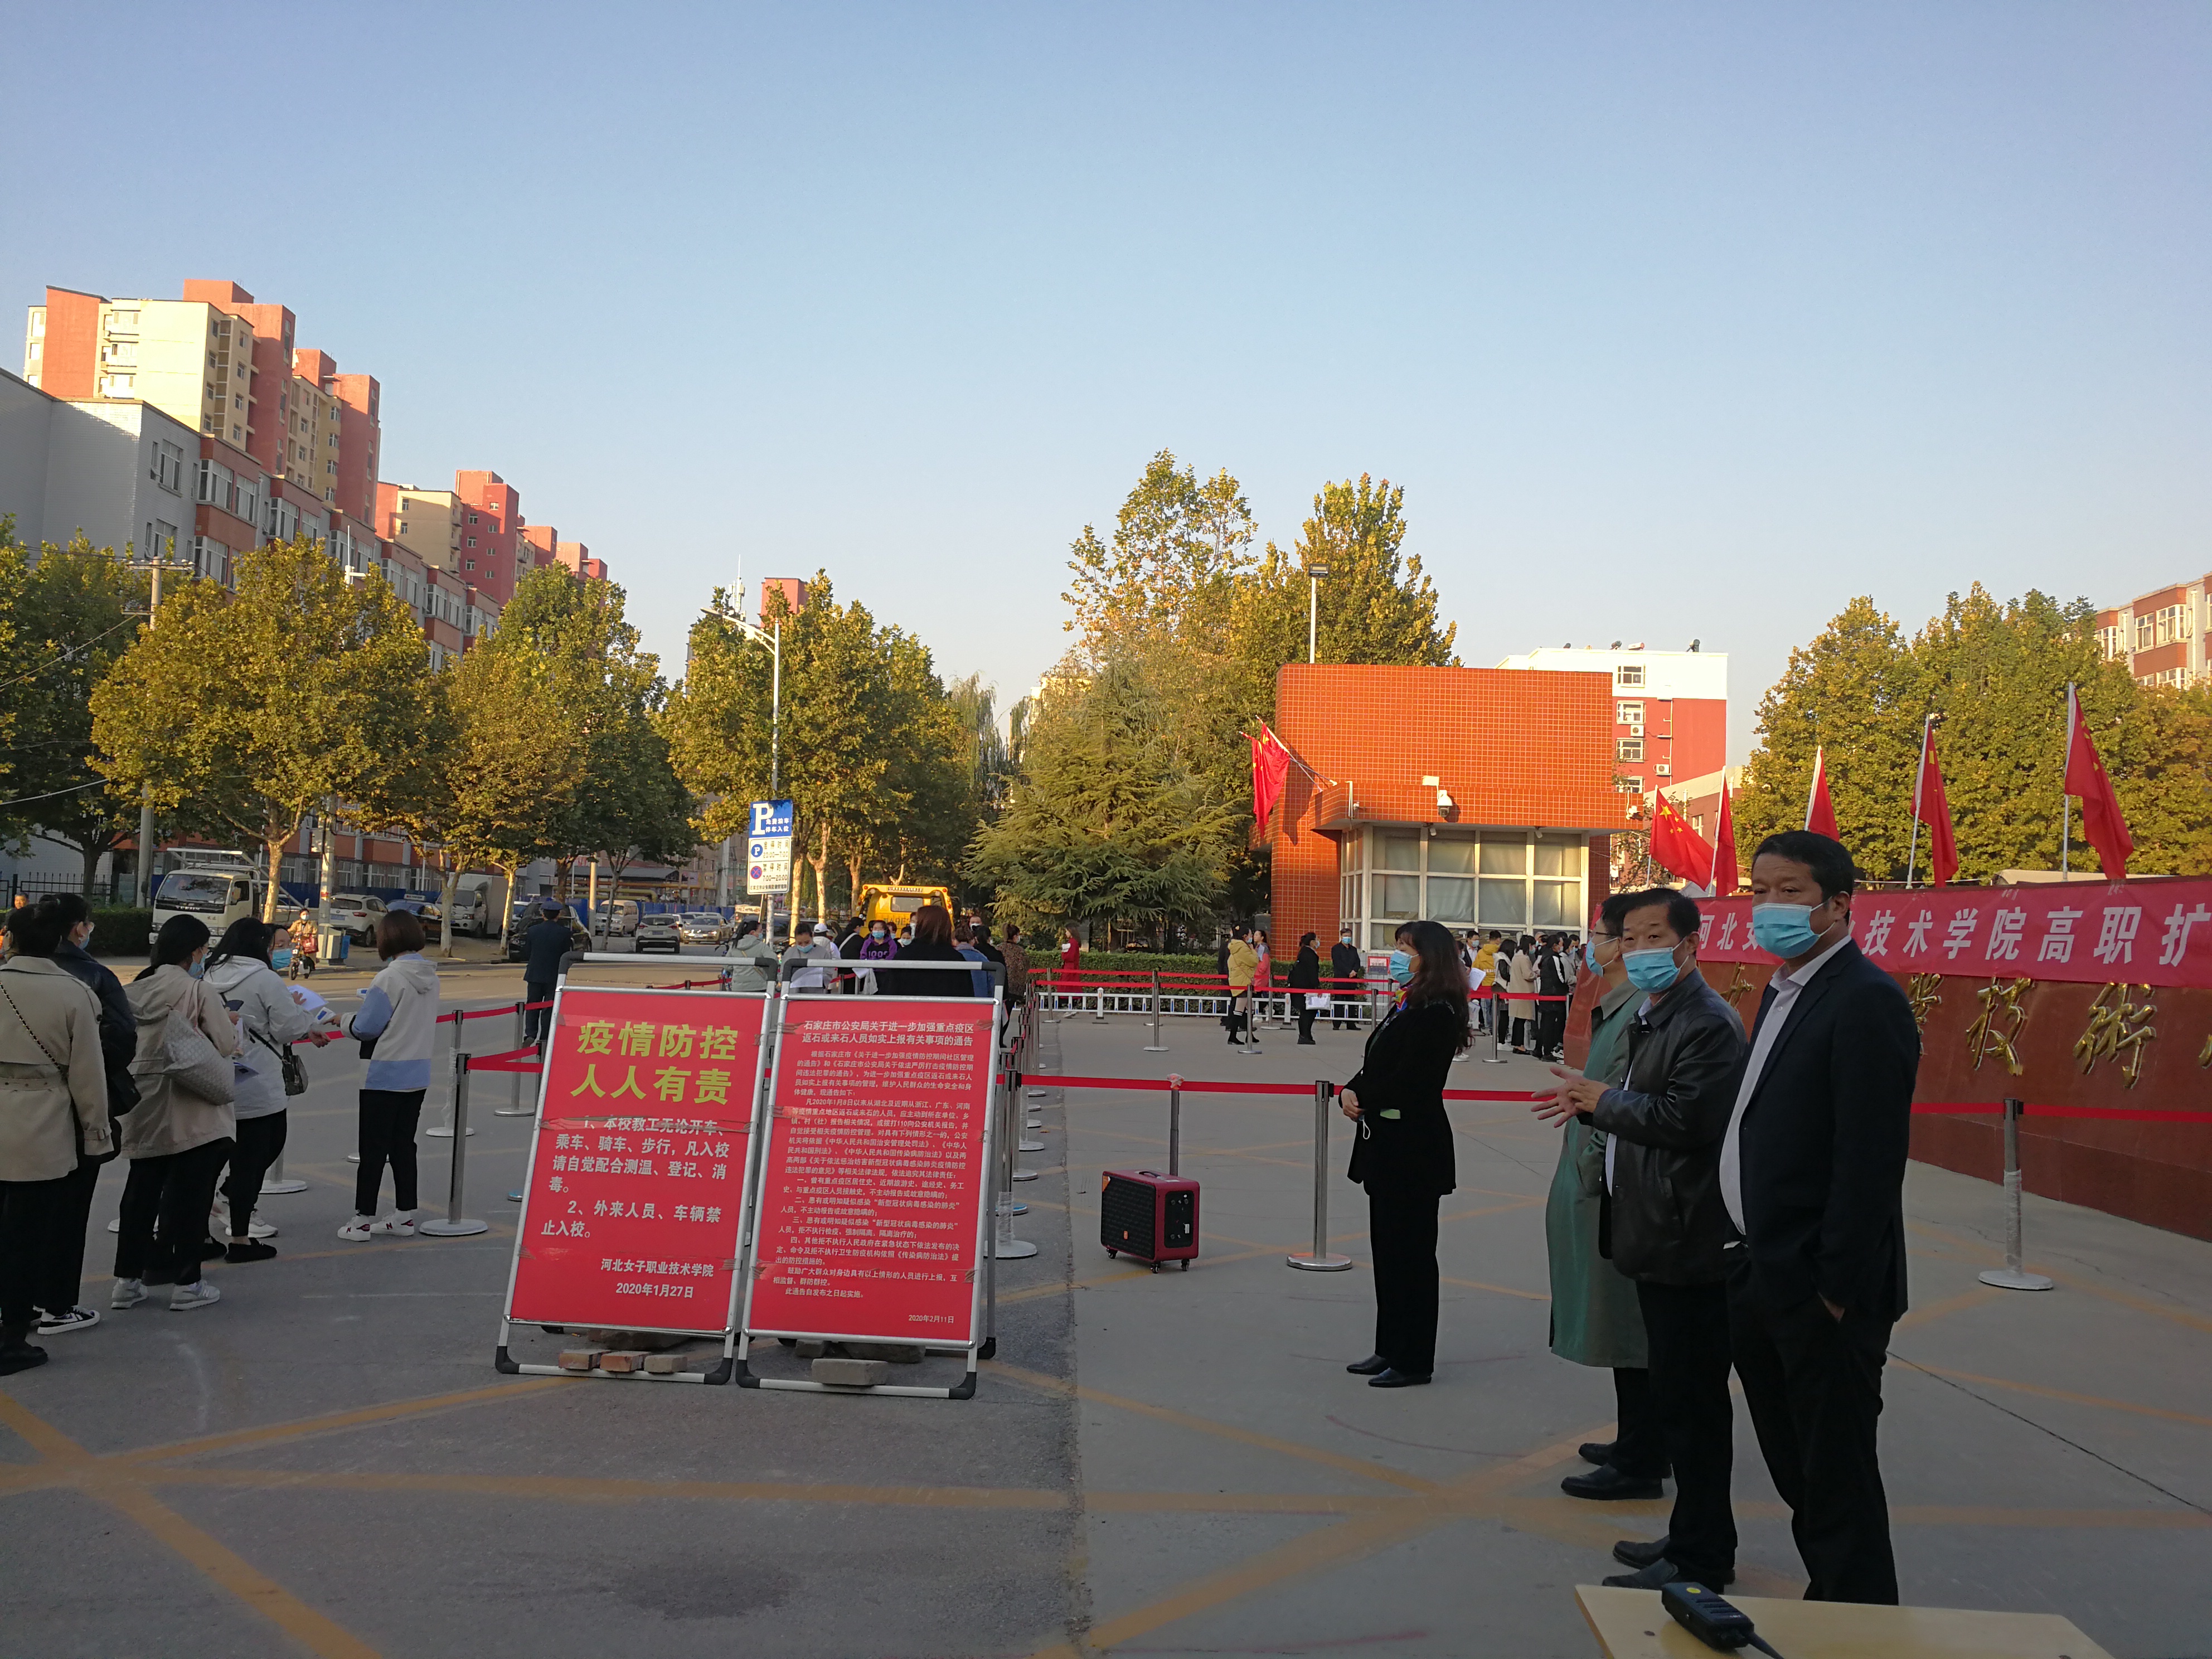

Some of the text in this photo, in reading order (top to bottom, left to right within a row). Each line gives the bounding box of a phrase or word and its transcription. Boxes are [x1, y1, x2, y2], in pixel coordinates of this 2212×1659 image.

[752, 803, 774, 835] P
[804, 1020, 974, 1032] 石家庄市公安局关于进一步加强重点疫区
[576, 1020, 739, 1060] 疫情防控
[802, 1032, 973, 1045] 返石或来石人员如实上报有关事项的通告
[570, 1064, 732, 1105] 人人有责
[555, 1133, 730, 1158] 乘车、骑车、步行，凡入校
[552, 1155, 727, 1180] 请自觉配合测温、登记、消
[549, 1176, 569, 1193] 毒。
[567, 1200, 722, 1223] 2、外来人员、车辆禁
[541, 1220, 591, 1239] 止入校。
[600, 1258, 714, 1277] 河北女子职业技术学院
[615, 1282, 693, 1298] 2020年1月27日
[908, 1313, 954, 1323] 2020年2月11日
